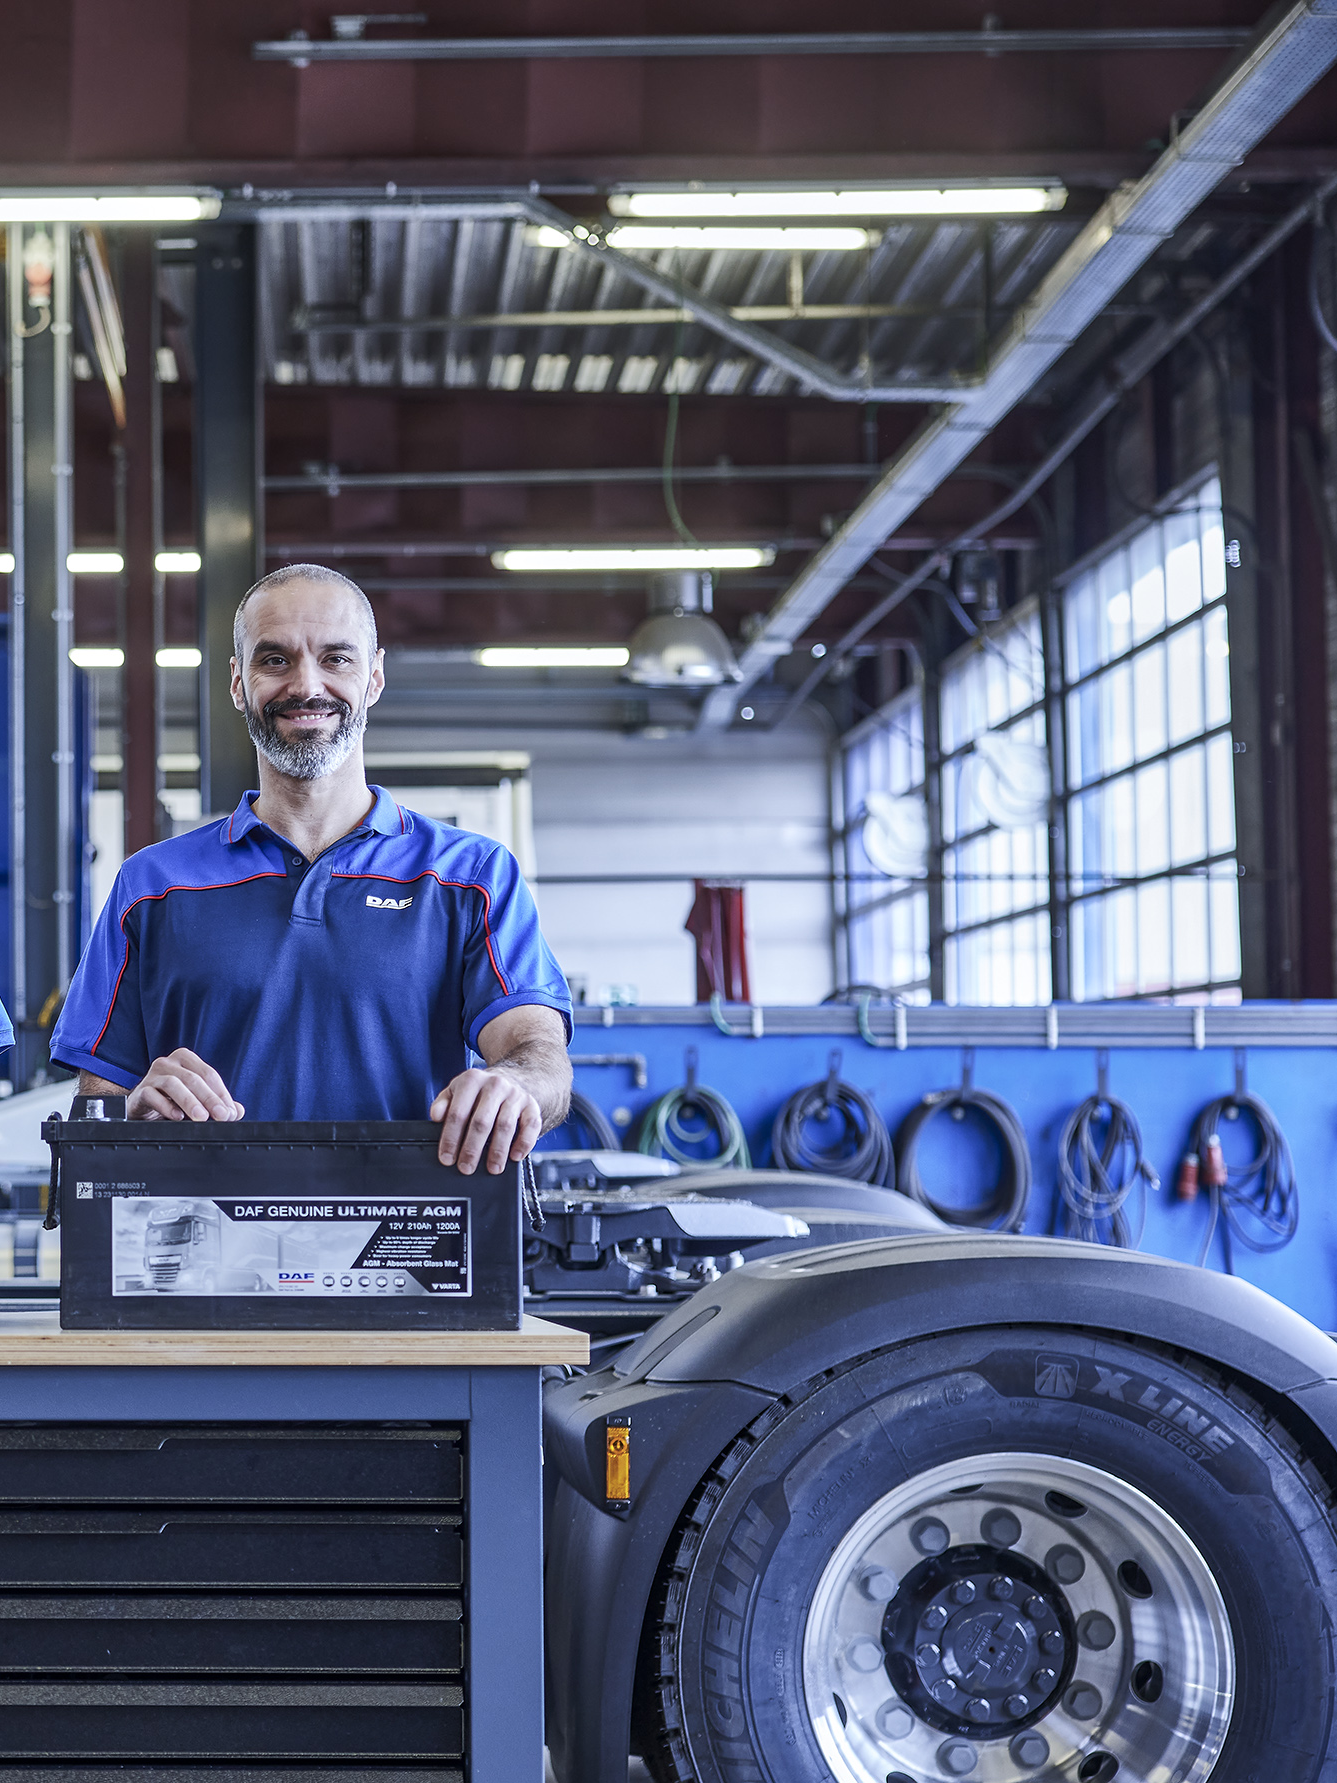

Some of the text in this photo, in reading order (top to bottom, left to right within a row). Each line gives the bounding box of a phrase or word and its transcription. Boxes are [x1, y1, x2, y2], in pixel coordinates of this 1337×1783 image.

[366, 895, 413, 909] DAF
[234, 1205, 461, 1217] DAF GENUINE ULTIMATE AGM
[389, 1222, 461, 1230] 12V 210Ah 1200A
[1090, 1365, 1236, 1455] X LINE
[1146, 1419, 1213, 1463] ENERGY
